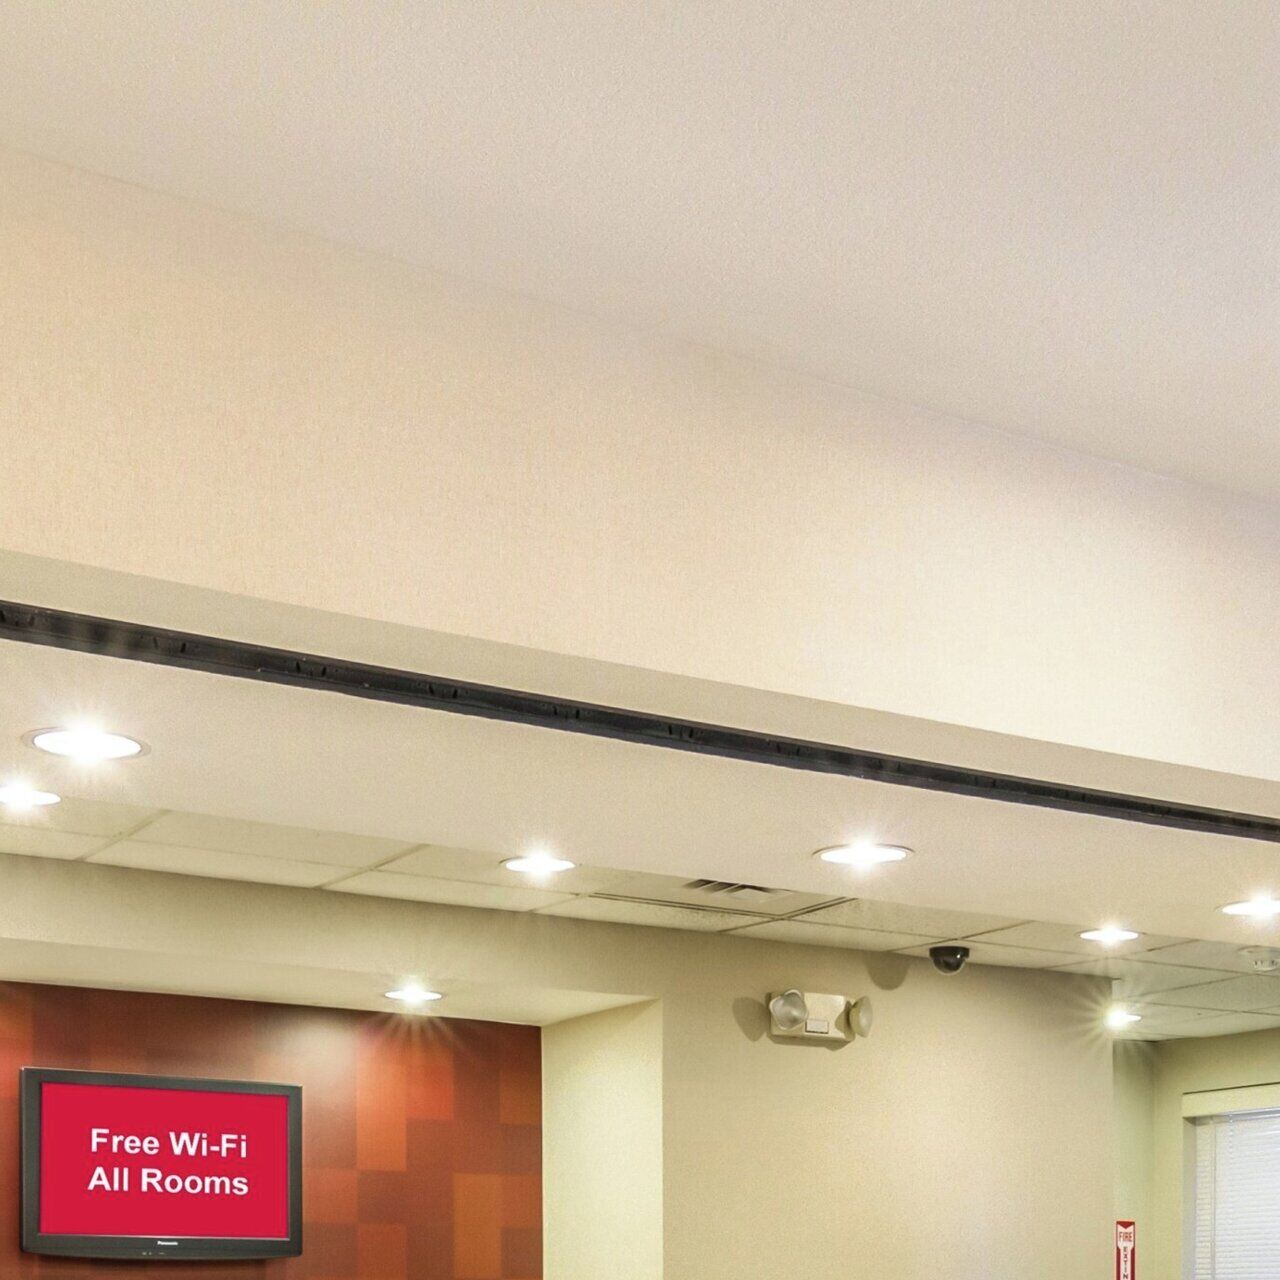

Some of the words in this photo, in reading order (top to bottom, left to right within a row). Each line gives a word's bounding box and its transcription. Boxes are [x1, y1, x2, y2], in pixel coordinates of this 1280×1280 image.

[91, 1128, 160, 1155] Free
[169, 1131, 248, 1158] Wi-Fi
[87, 1166, 129, 1192] All
[141, 1168, 249, 1196] Rooms
[1119, 1232, 1133, 1241] FIRE
